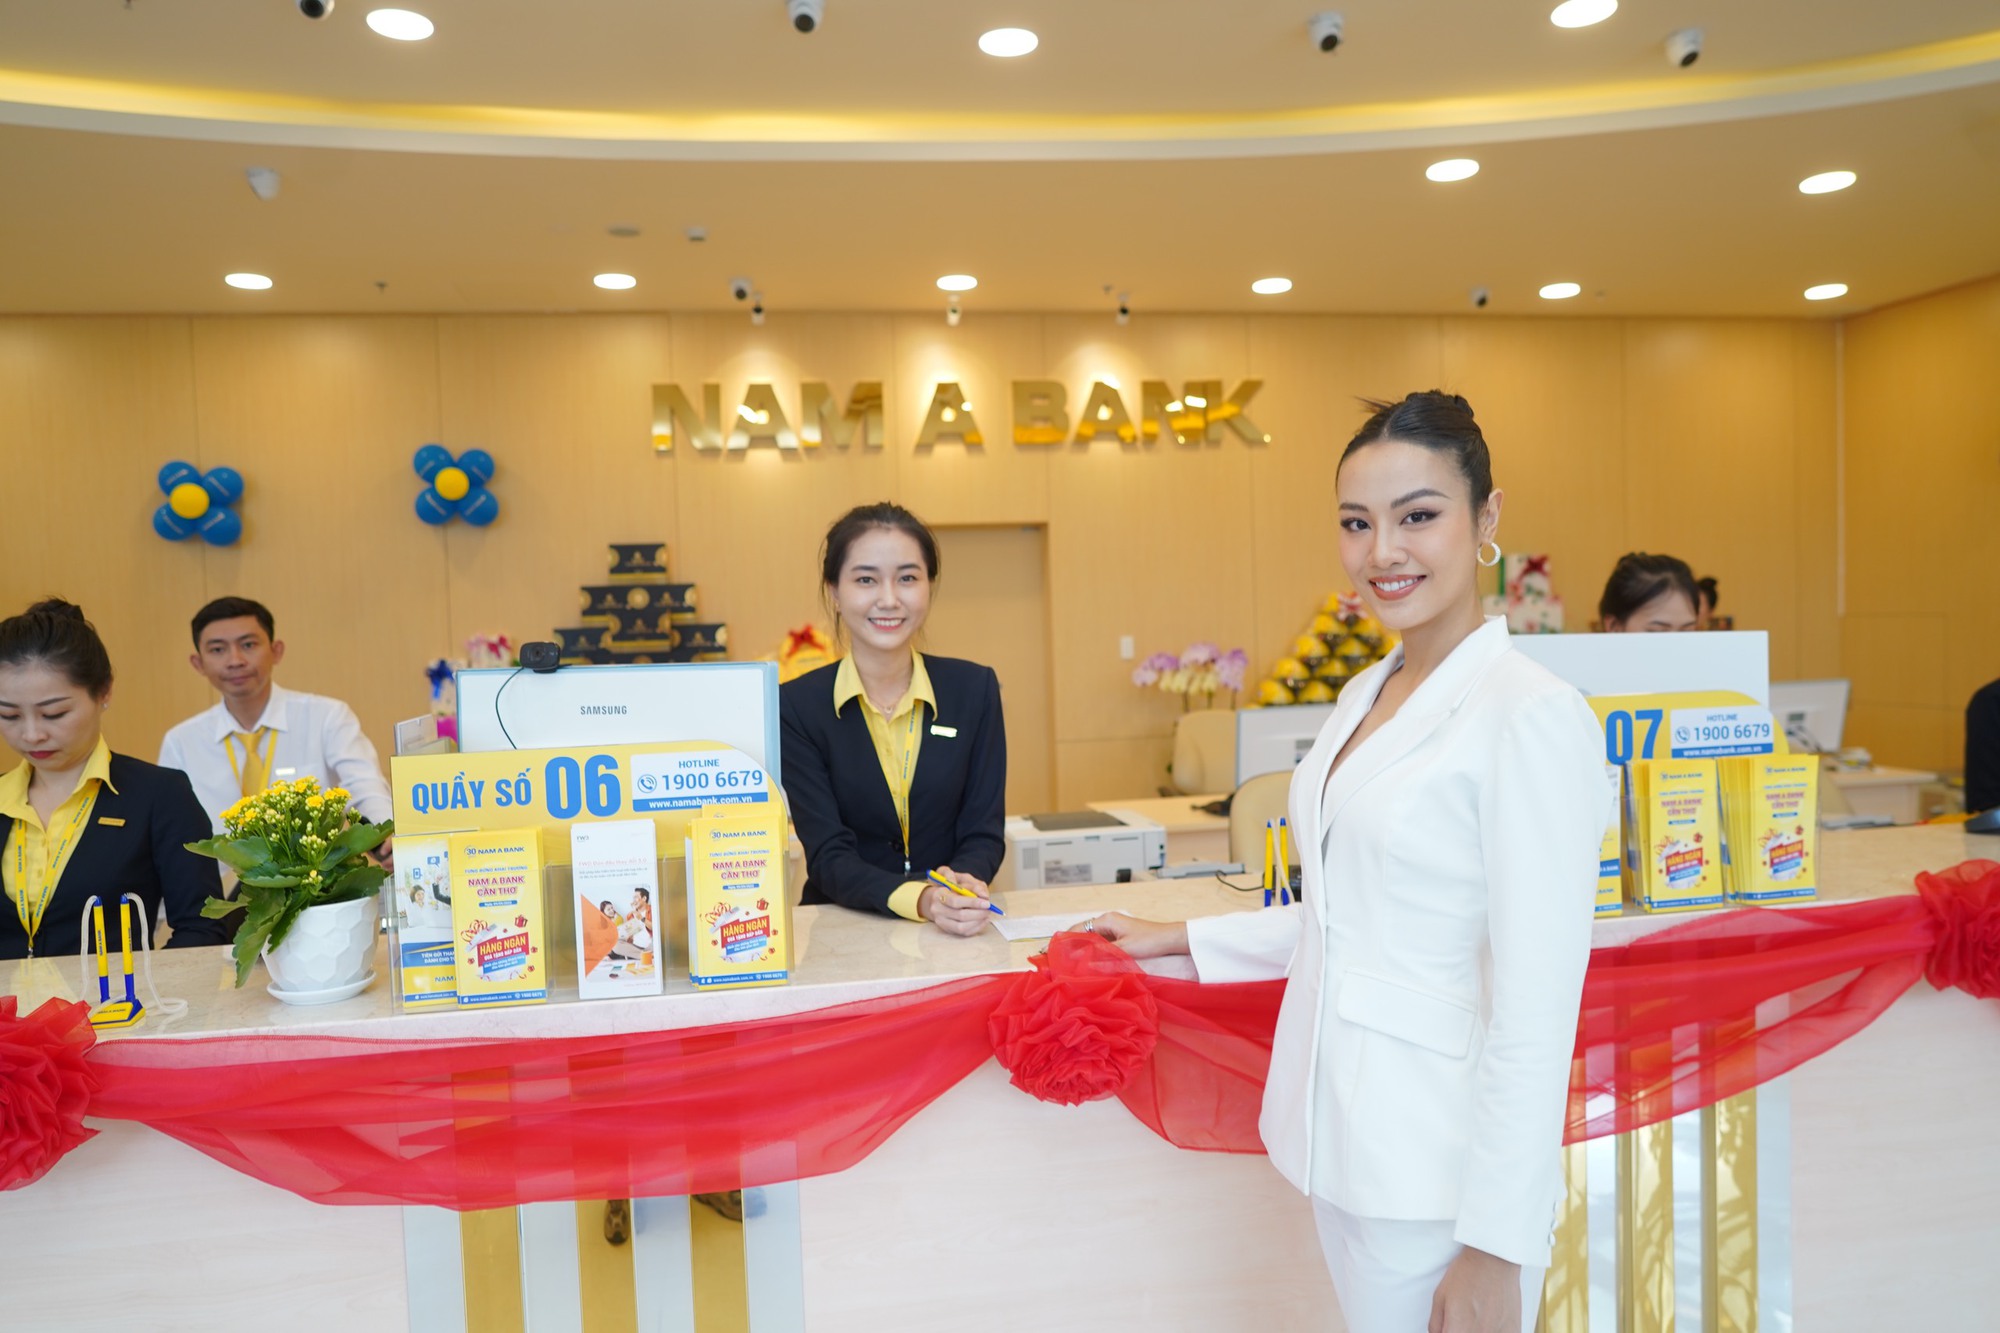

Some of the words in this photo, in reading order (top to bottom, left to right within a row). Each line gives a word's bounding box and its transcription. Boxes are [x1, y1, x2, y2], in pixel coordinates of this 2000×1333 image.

[651, 382, 884, 451] NAM
[915, 381, 985, 449] A
[1011, 379, 1269, 447] BANK
[580, 706, 627, 715] SAMSUNG
[1707, 714, 1738, 722] HOTLINE
[1605, 709, 1663, 766] 07
[1694, 725, 1730, 741] 1900
[1734, 723, 1770, 738] 6679
[679, 759, 720, 768] HOTLINE
[412, 772, 485, 814] QUẦY
[495, 768, 532, 807] SỐ
[544, 754, 622, 819] 06
[662, 772, 709, 790] 1900
[715, 770, 763, 788] 6679
[649, 795, 752, 808] www.namabank.com.vn
[713, 862, 732, 870] NAM
[743, 860, 766, 868] BANK
[468, 878, 489, 886] NAM
[500, 876, 524, 884] BANK
[723, 924, 744, 937] HÀNG
[746, 918, 767, 931] NGÀN
[480, 941, 502, 955] HÀNG
[504, 935, 526, 950] NGÀN
